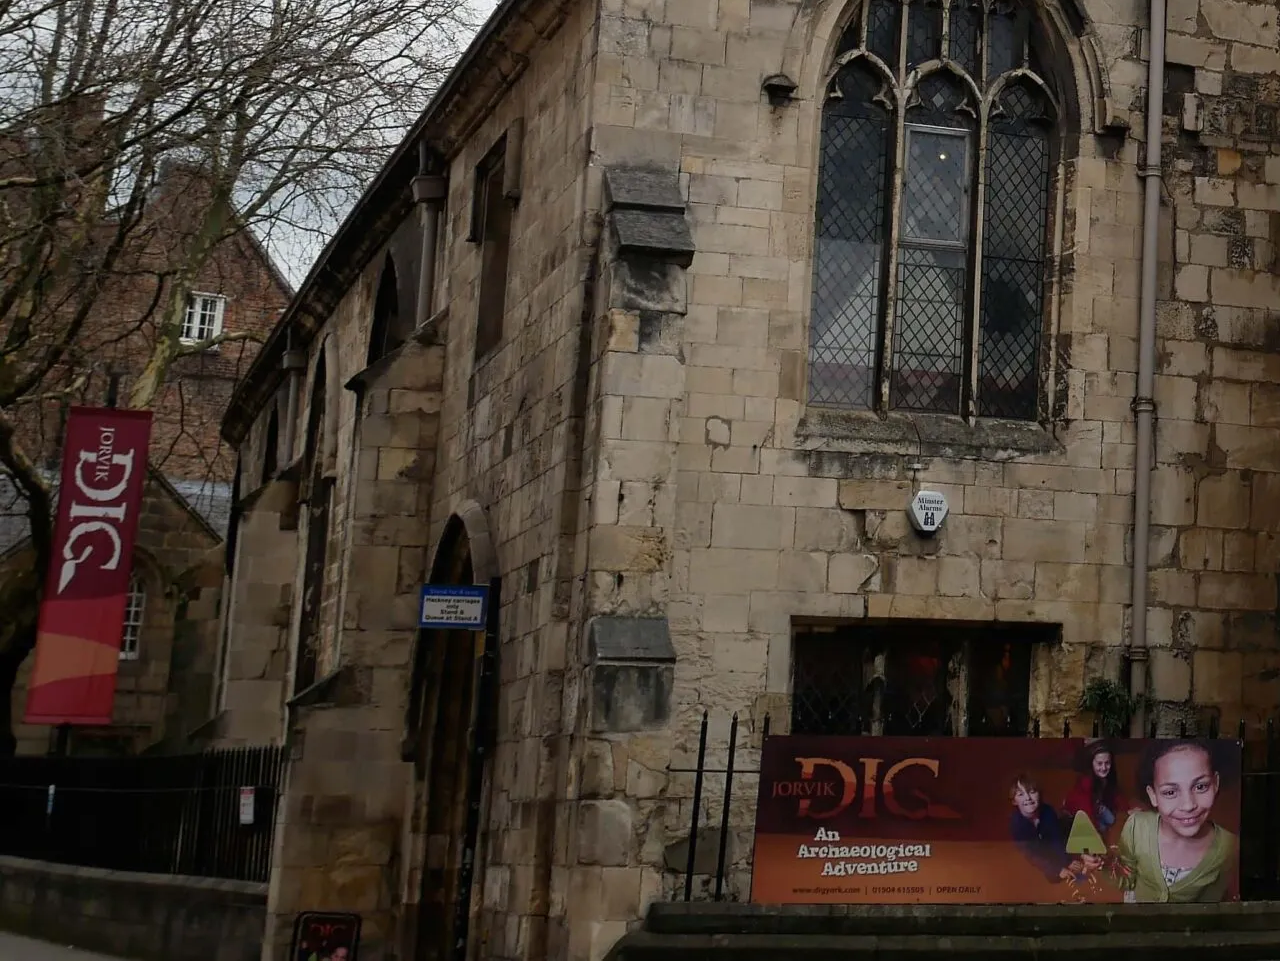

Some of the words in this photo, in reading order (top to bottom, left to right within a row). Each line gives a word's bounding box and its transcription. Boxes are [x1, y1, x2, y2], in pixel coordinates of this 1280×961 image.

[93, 426, 115, 481] JORVIK
[917, 497, 944, 505] Minster
[918, 504, 943, 512] Alarms
[57, 449, 135, 594] DIG
[771, 780, 836, 798] JORVIK
[794, 757, 962, 820] DIG
[813, 826, 840, 842] An
[796, 842, 931, 861] Archaeological
[821, 858, 918, 876] Adventure
[792, 886, 861, 895] www.digyork.com
[872, 886, 895, 894] 01904
[897, 886, 925, 894] 615505
[936, 886, 957, 894] OPEN
[958, 886, 982, 894] DAILY
